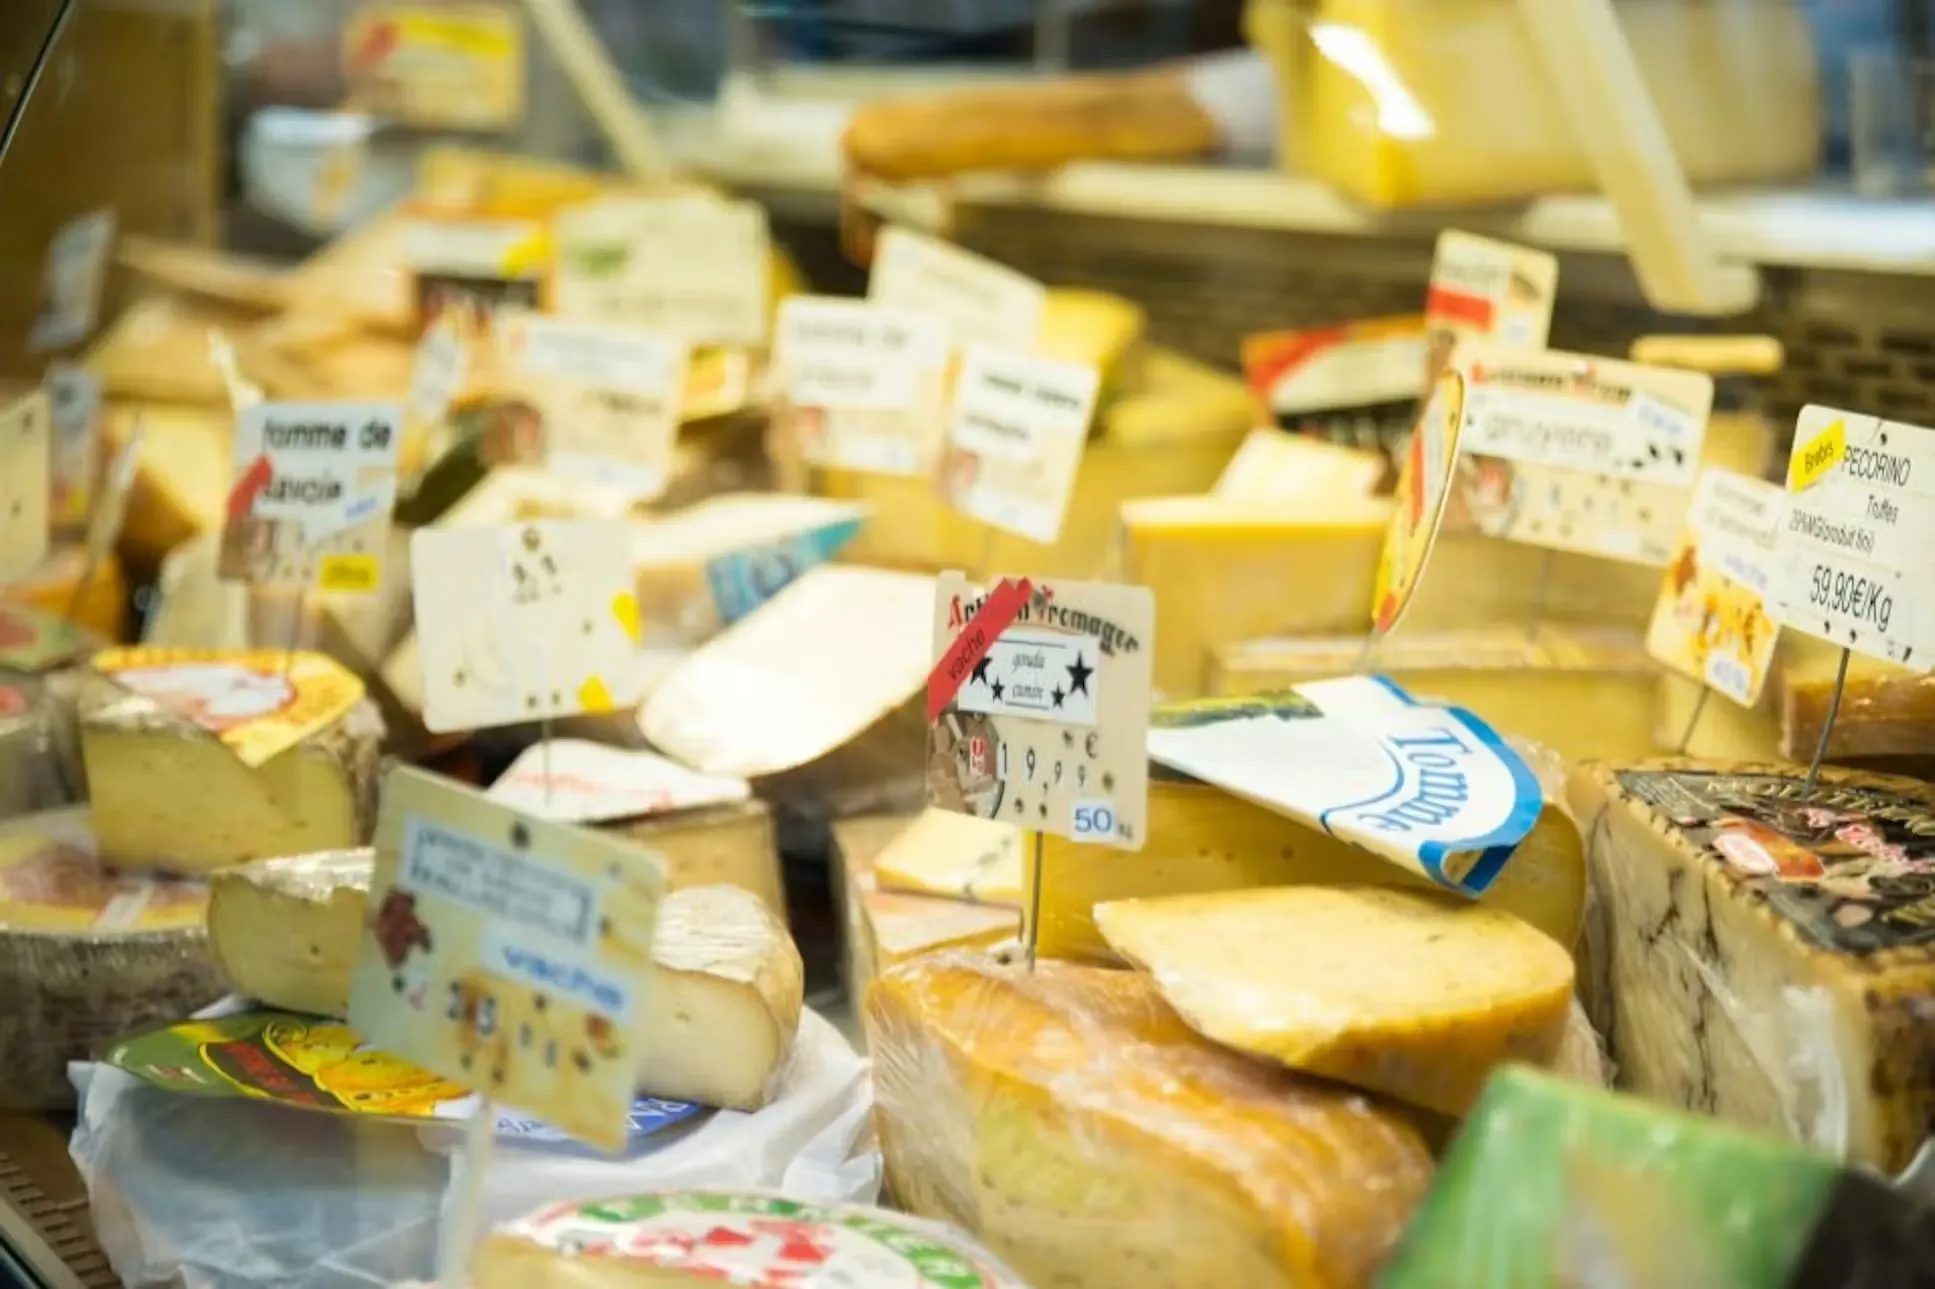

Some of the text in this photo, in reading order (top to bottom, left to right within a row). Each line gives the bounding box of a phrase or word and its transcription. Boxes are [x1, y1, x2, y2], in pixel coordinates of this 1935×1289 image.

[1843, 443, 1912, 488] PECORINO
[1357, 726, 1473, 833] Tomme
[1074, 807, 1113, 833] 50
